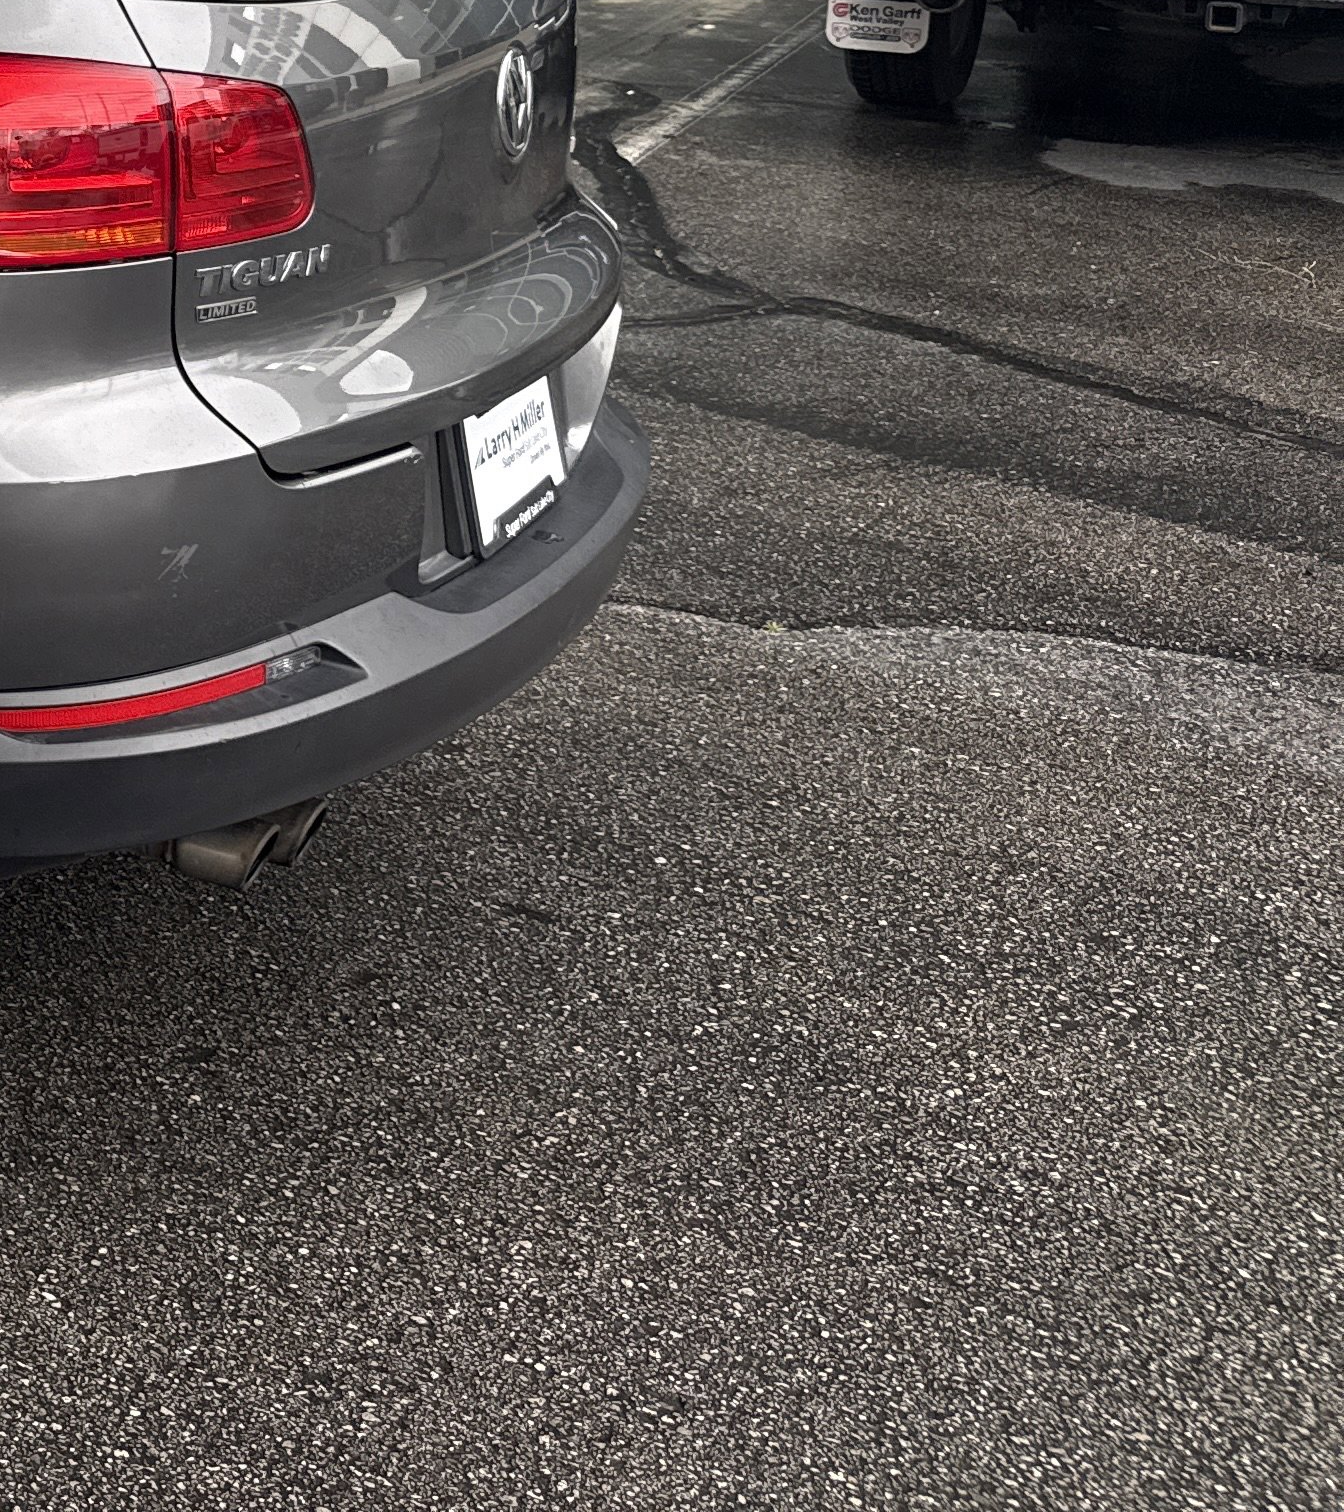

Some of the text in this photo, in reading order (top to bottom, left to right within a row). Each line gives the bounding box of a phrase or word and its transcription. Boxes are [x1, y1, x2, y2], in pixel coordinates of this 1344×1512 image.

[849, 3, 922, 20] Ken Garff
[849, 24, 901, 35] DODGE
[194, 243, 331, 297] TIGUAN
[198, 299, 258, 321] LIMITED
[484, 426, 513, 460] Larry
[511, 415, 521, 441] H
[520, 398, 545, 435] Miller
